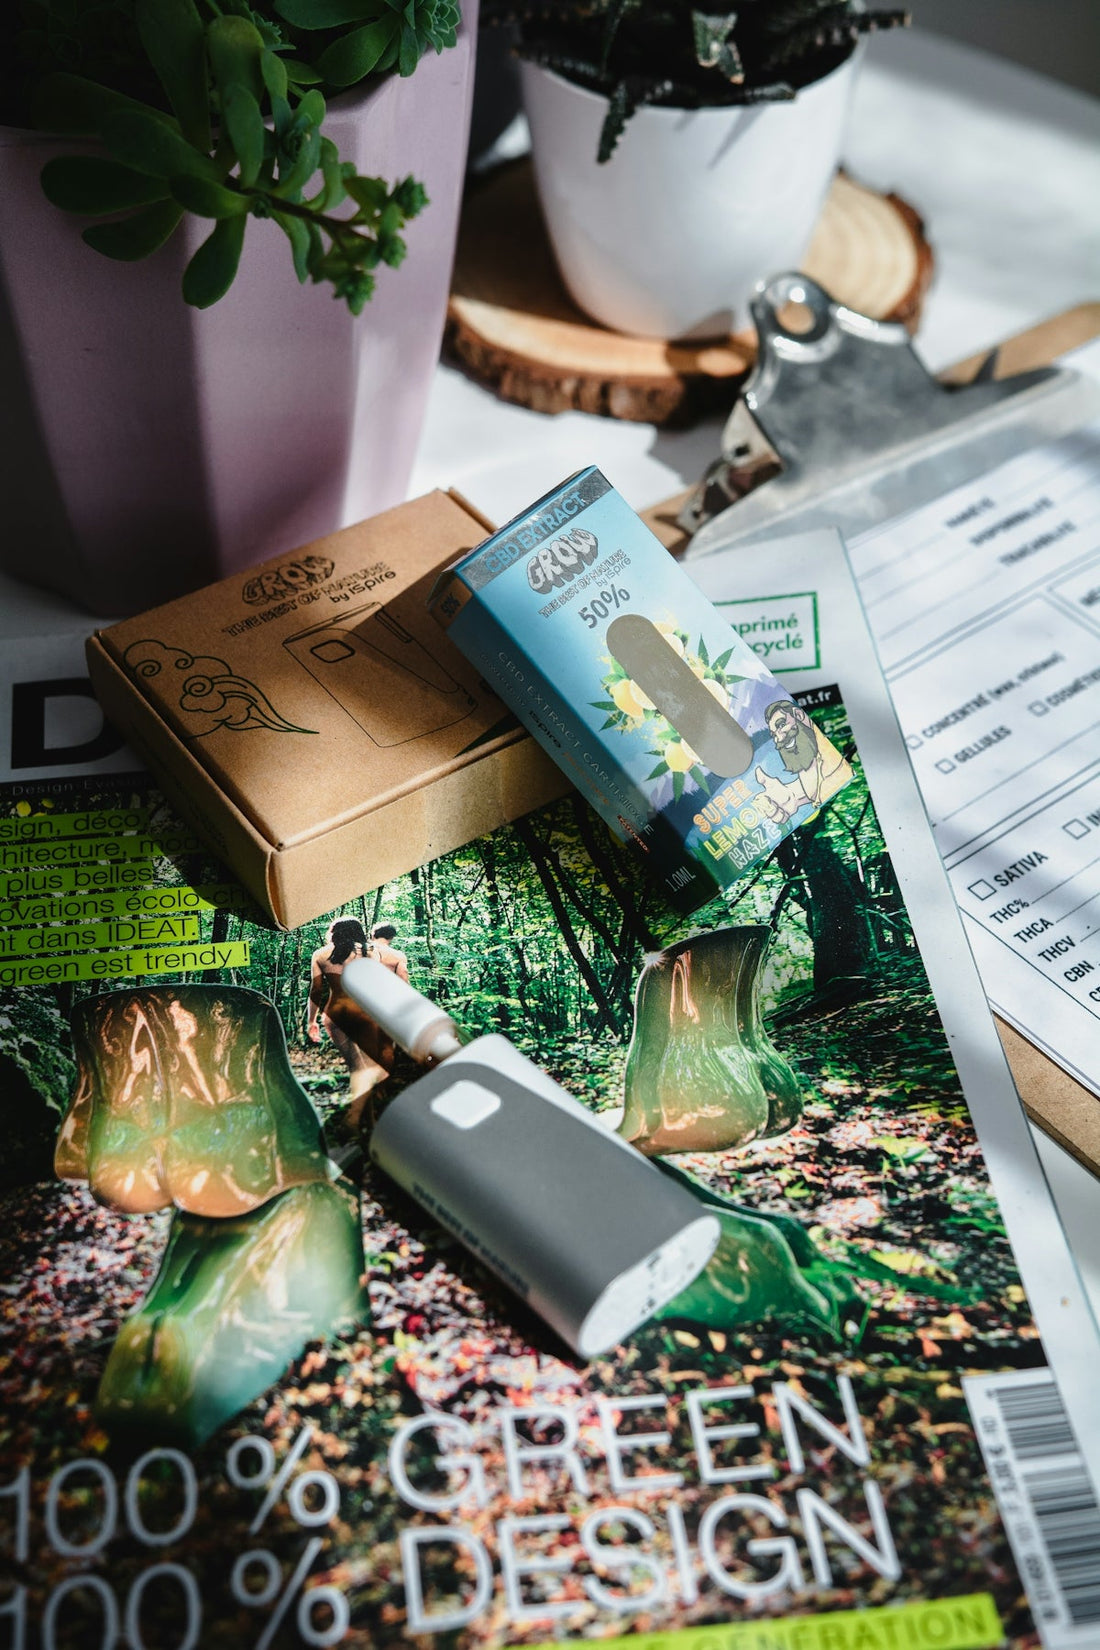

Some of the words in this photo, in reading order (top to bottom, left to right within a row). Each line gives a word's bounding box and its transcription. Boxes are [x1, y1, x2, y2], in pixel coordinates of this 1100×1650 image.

[485, 542, 520, 573] CBD
[516, 491, 585, 550] EXTRACT
[330, 592, 350, 604] by
[538, 598, 561, 619] THE
[557, 583, 580, 606] BEST
[577, 575, 591, 590] OF
[590, 548, 627, 579] NATURE
[595, 577, 608, 588] by
[578, 583, 631, 629] 50%
[222, 613, 262, 637] THE
[730, 612, 799, 638] primé
[747, 632, 804, 657] cyclé
[498, 651, 525, 683] CBD
[526, 685, 583, 747] EXTRACT
[12, 782, 74, 797] Design
[693, 779, 754, 834] SUPER
[703, 794, 776, 861] LEMON
[728, 817, 782, 870] HAZE
[3, 842, 127, 865] hitecture,
[993, 851, 1050, 888] SATIVA
[7, 873, 63, 898] plus
[74, 865, 152, 887] belles
[0, 899, 115, 922] ovations
[989, 897, 1030, 925] THC%
[27, 930, 97, 950] dans
[108, 917, 196, 942] IDEAT.
[1013, 917, 1055, 944] THCA
[1037, 935, 1077, 963] THCV
[0, 962, 79, 988] green
[91, 953, 133, 975] est
[144, 945, 232, 969] trendy
[1063, 959, 1095, 983] CBN
[0, 1447, 198, 1563] 100
[388, 1374, 873, 1514] GREEN
[400, 1480, 902, 1635] DESIGN
